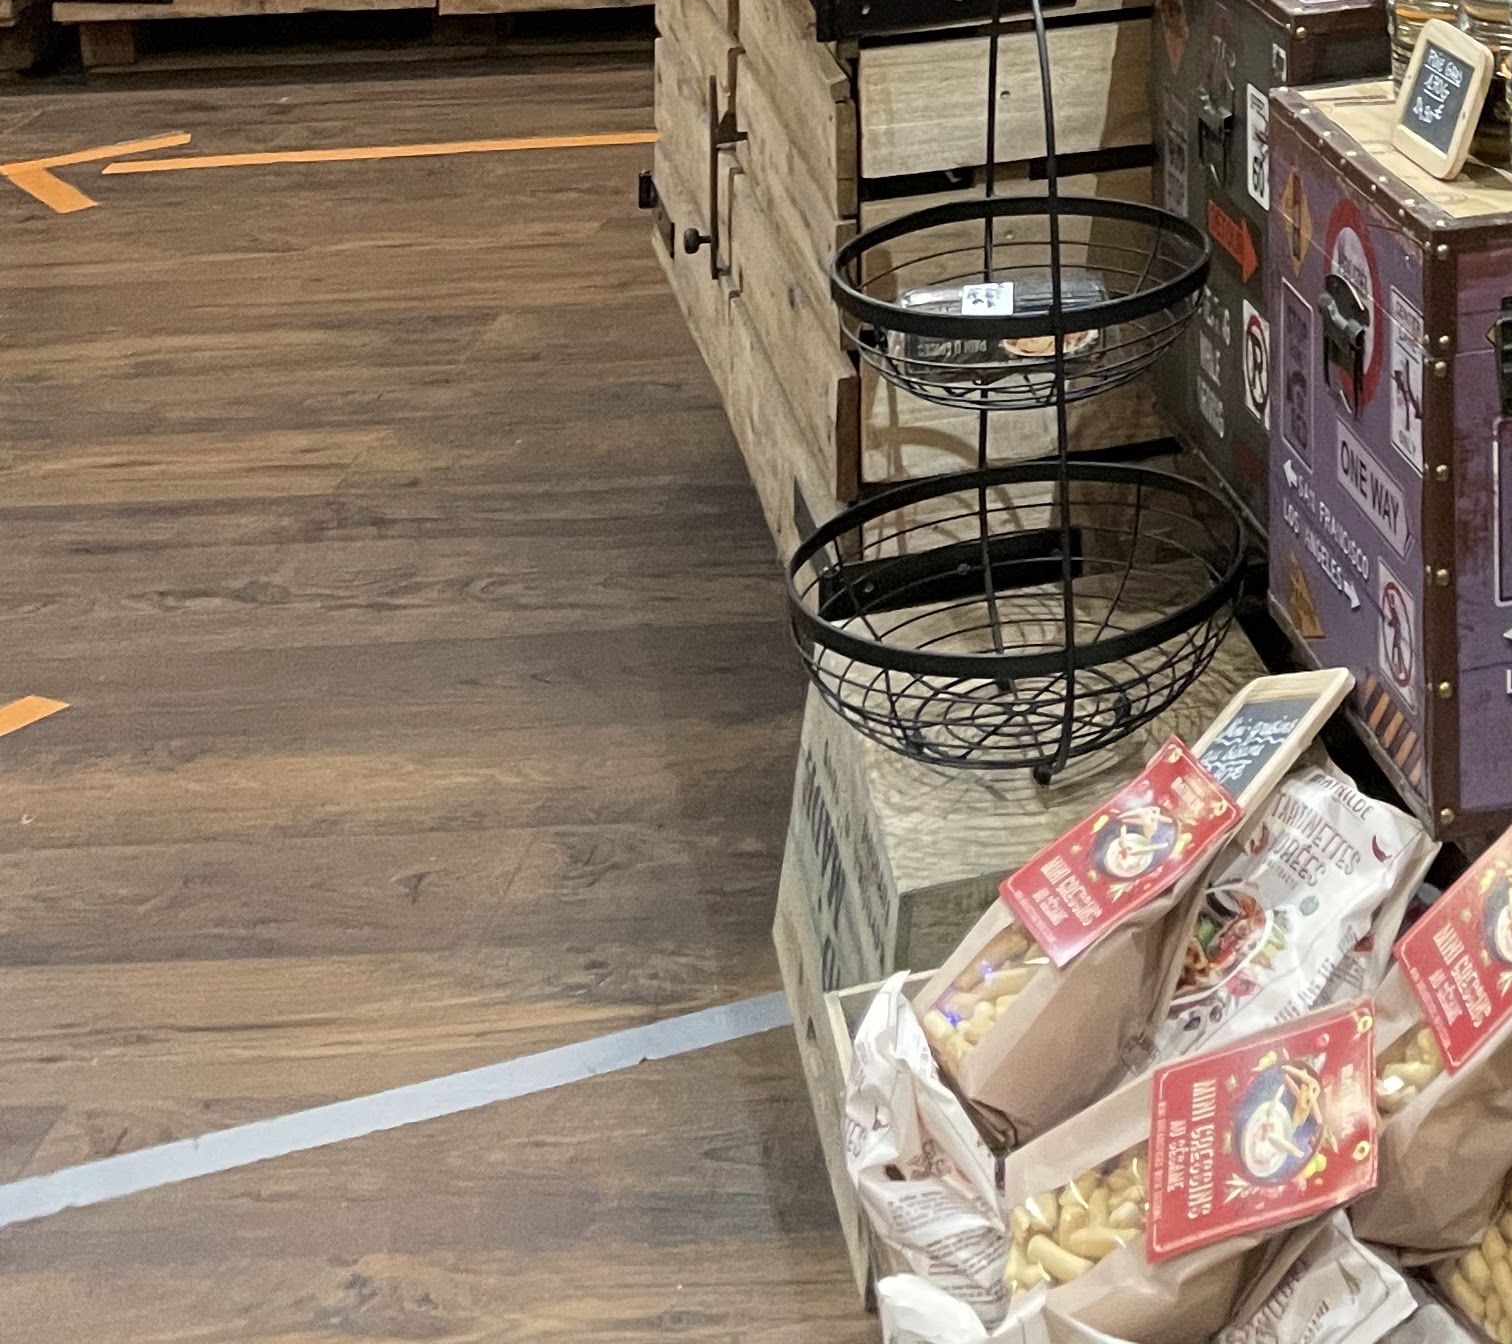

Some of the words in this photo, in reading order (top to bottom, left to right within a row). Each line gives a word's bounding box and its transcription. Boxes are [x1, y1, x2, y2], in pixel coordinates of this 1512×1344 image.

[1340, 440, 1369, 498] ONE
[1369, 477, 1401, 536] WAY
[1309, 772, 1376, 821] MATHILDE
[1269, 791, 1362, 877] TARTINETTES
[1432, 922, 1466, 967] MINI
[1191, 1078, 1217, 1123] MINI
[1169, 1119, 1188, 1139] AU
